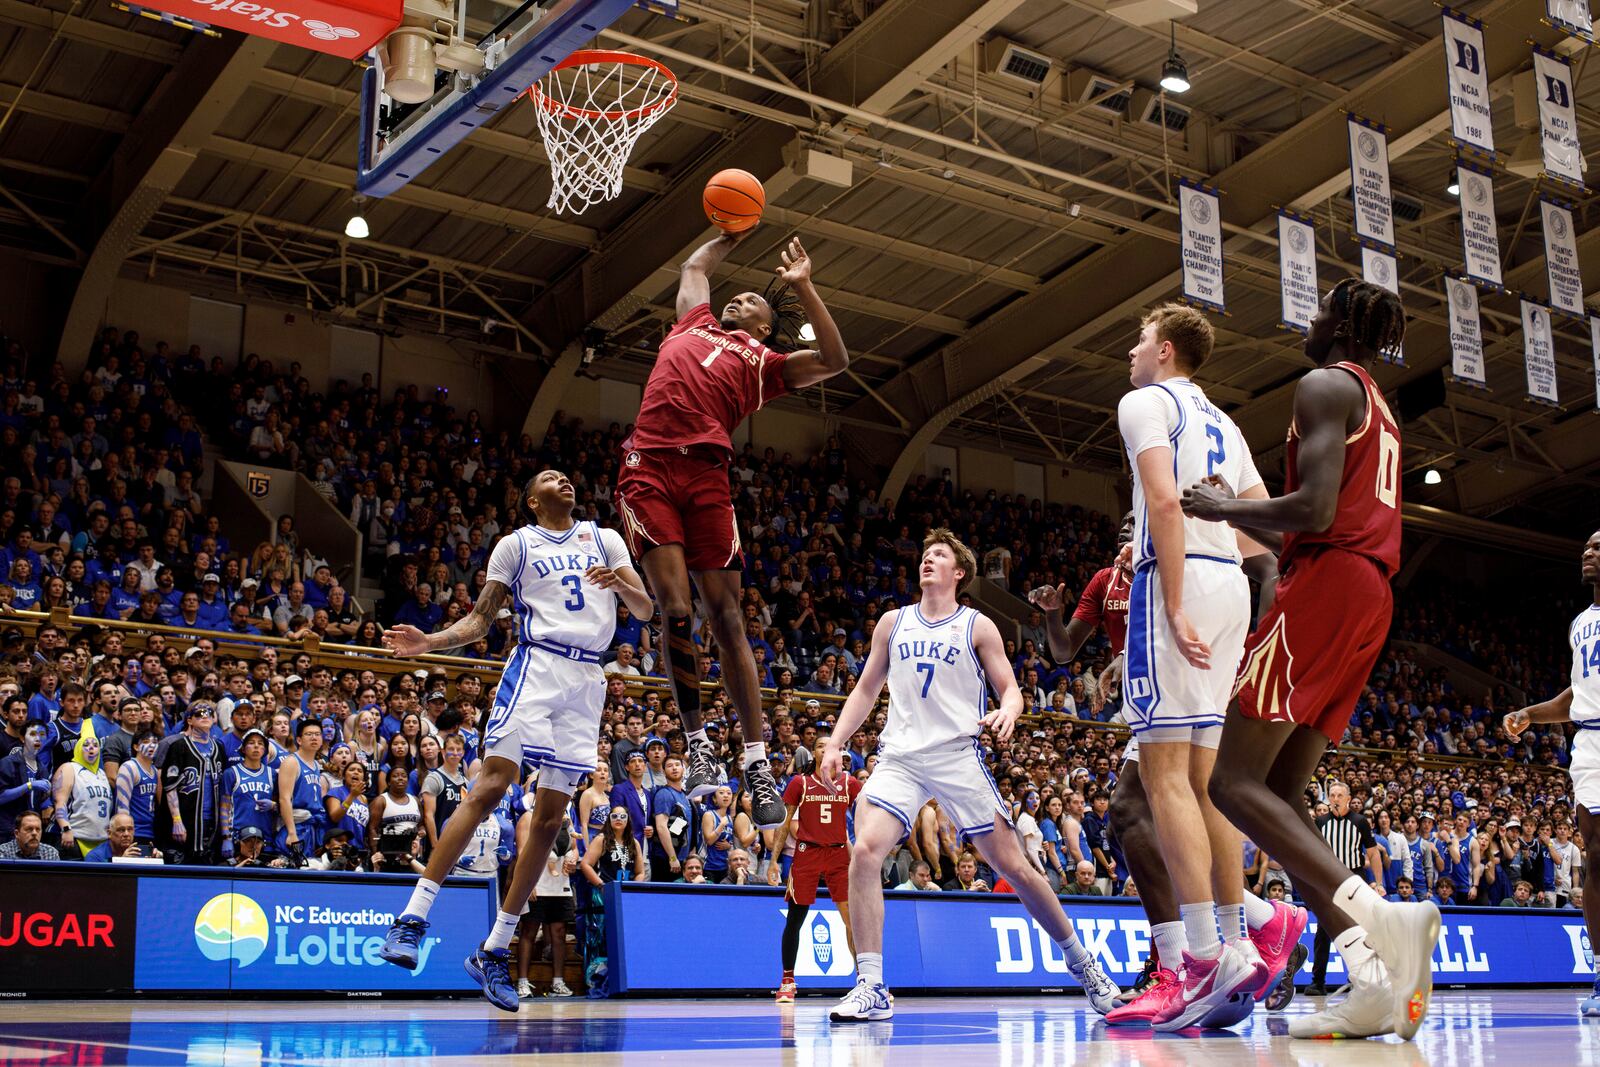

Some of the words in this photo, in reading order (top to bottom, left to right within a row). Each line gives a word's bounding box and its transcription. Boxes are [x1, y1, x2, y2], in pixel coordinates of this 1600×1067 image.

[191, 0, 300, 28] Stat
[1461, 83, 1479, 97] NCAA
[1453, 96, 1472, 111] FINAL
[1473, 103, 1490, 117] FOUR
[1552, 117, 1569, 130] NCAA
[1359, 167, 1383, 184] ATLANTIC
[1363, 178, 1381, 191] COAST
[1356, 186, 1390, 207] CONFERENCE
[1358, 196, 1390, 216] CHAMPIONS
[1468, 210, 1491, 225] ATLANTIC
[1368, 223, 1384, 236] 1964
[1473, 221, 1488, 233] COAST
[1188, 229, 1216, 246] ATLANTIC
[1465, 228, 1498, 247] CONFERENCE
[1194, 241, 1212, 254] COAST
[1468, 239, 1498, 256] CHAMPIONS
[1551, 243, 1573, 257] ATLANTIC
[1184, 248, 1221, 268] CONFERENCE
[1287, 260, 1312, 274] ATLANTIC
[1555, 254, 1570, 265] COAST
[1185, 259, 1220, 277] CHAMPIONS
[1291, 271, 1308, 283] COAST
[1549, 260, 1580, 278] CONFERENCE
[1283, 278, 1317, 295] CONFERENCE
[1551, 271, 1580, 287] CHAMPIONS
[1197, 284, 1213, 297] 2002
[1285, 288, 1317, 305] CHAMPIONS
[690, 328, 760, 366] SEMINOLES
[700, 345, 724, 368] 1
[1205, 422, 1226, 477] 2
[252, 479, 267, 494] 15
[532, 554, 599, 579] DUKE
[561, 574, 586, 612] 3
[898, 640, 961, 666] DUKE
[1580, 639, 1600, 679] 14
[916, 662, 936, 699] 7
[240, 781, 272, 794] DUKE
[805, 794, 848, 803] SEMINOLES
[97, 800, 108, 818] 3
[820, 803, 832, 824] 5
[479, 839, 485, 857] 1
[275, 905, 305, 924] NC
[309, 906, 396, 926] Education
[0, 912, 116, 948] UGAR
[275, 925, 436, 977] Lottey
[990, 916, 1152, 974] DUKE
